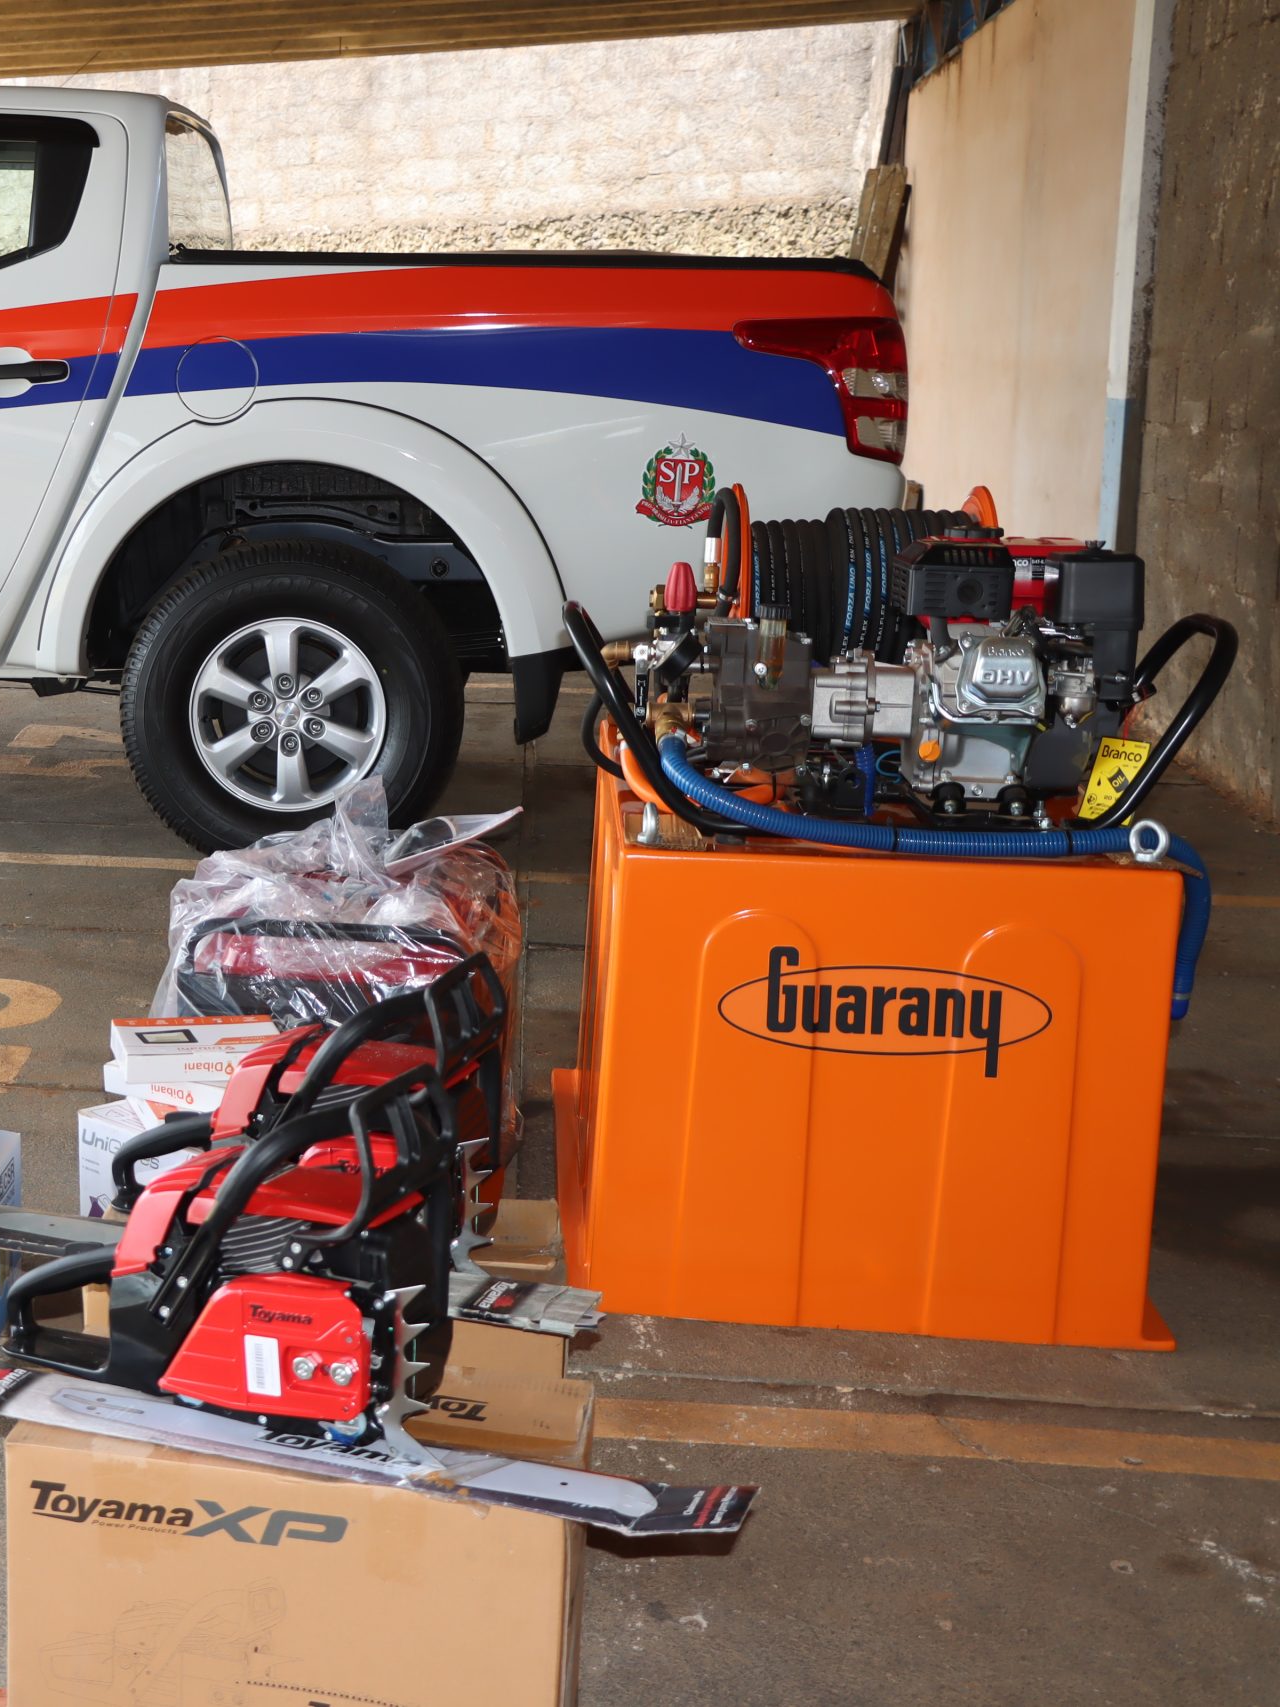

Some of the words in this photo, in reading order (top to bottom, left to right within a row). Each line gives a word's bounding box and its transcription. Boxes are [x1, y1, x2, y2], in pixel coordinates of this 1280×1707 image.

[981, 669, 1032, 686] OHV
[1101, 744, 1143, 763] Branco
[1111, 775, 1126, 788] OIL
[767, 945, 1003, 1078] Guarany
[184, 1061, 224, 1074] Dibani
[150, 1083, 184, 1100] Dibani
[249, 1303, 314, 1326] Toyama
[29, 1479, 195, 1528] Toyama
[181, 1498, 349, 1547] XP
[91, 1519, 126, 1530] Power
[127, 1523, 179, 1536] Products
